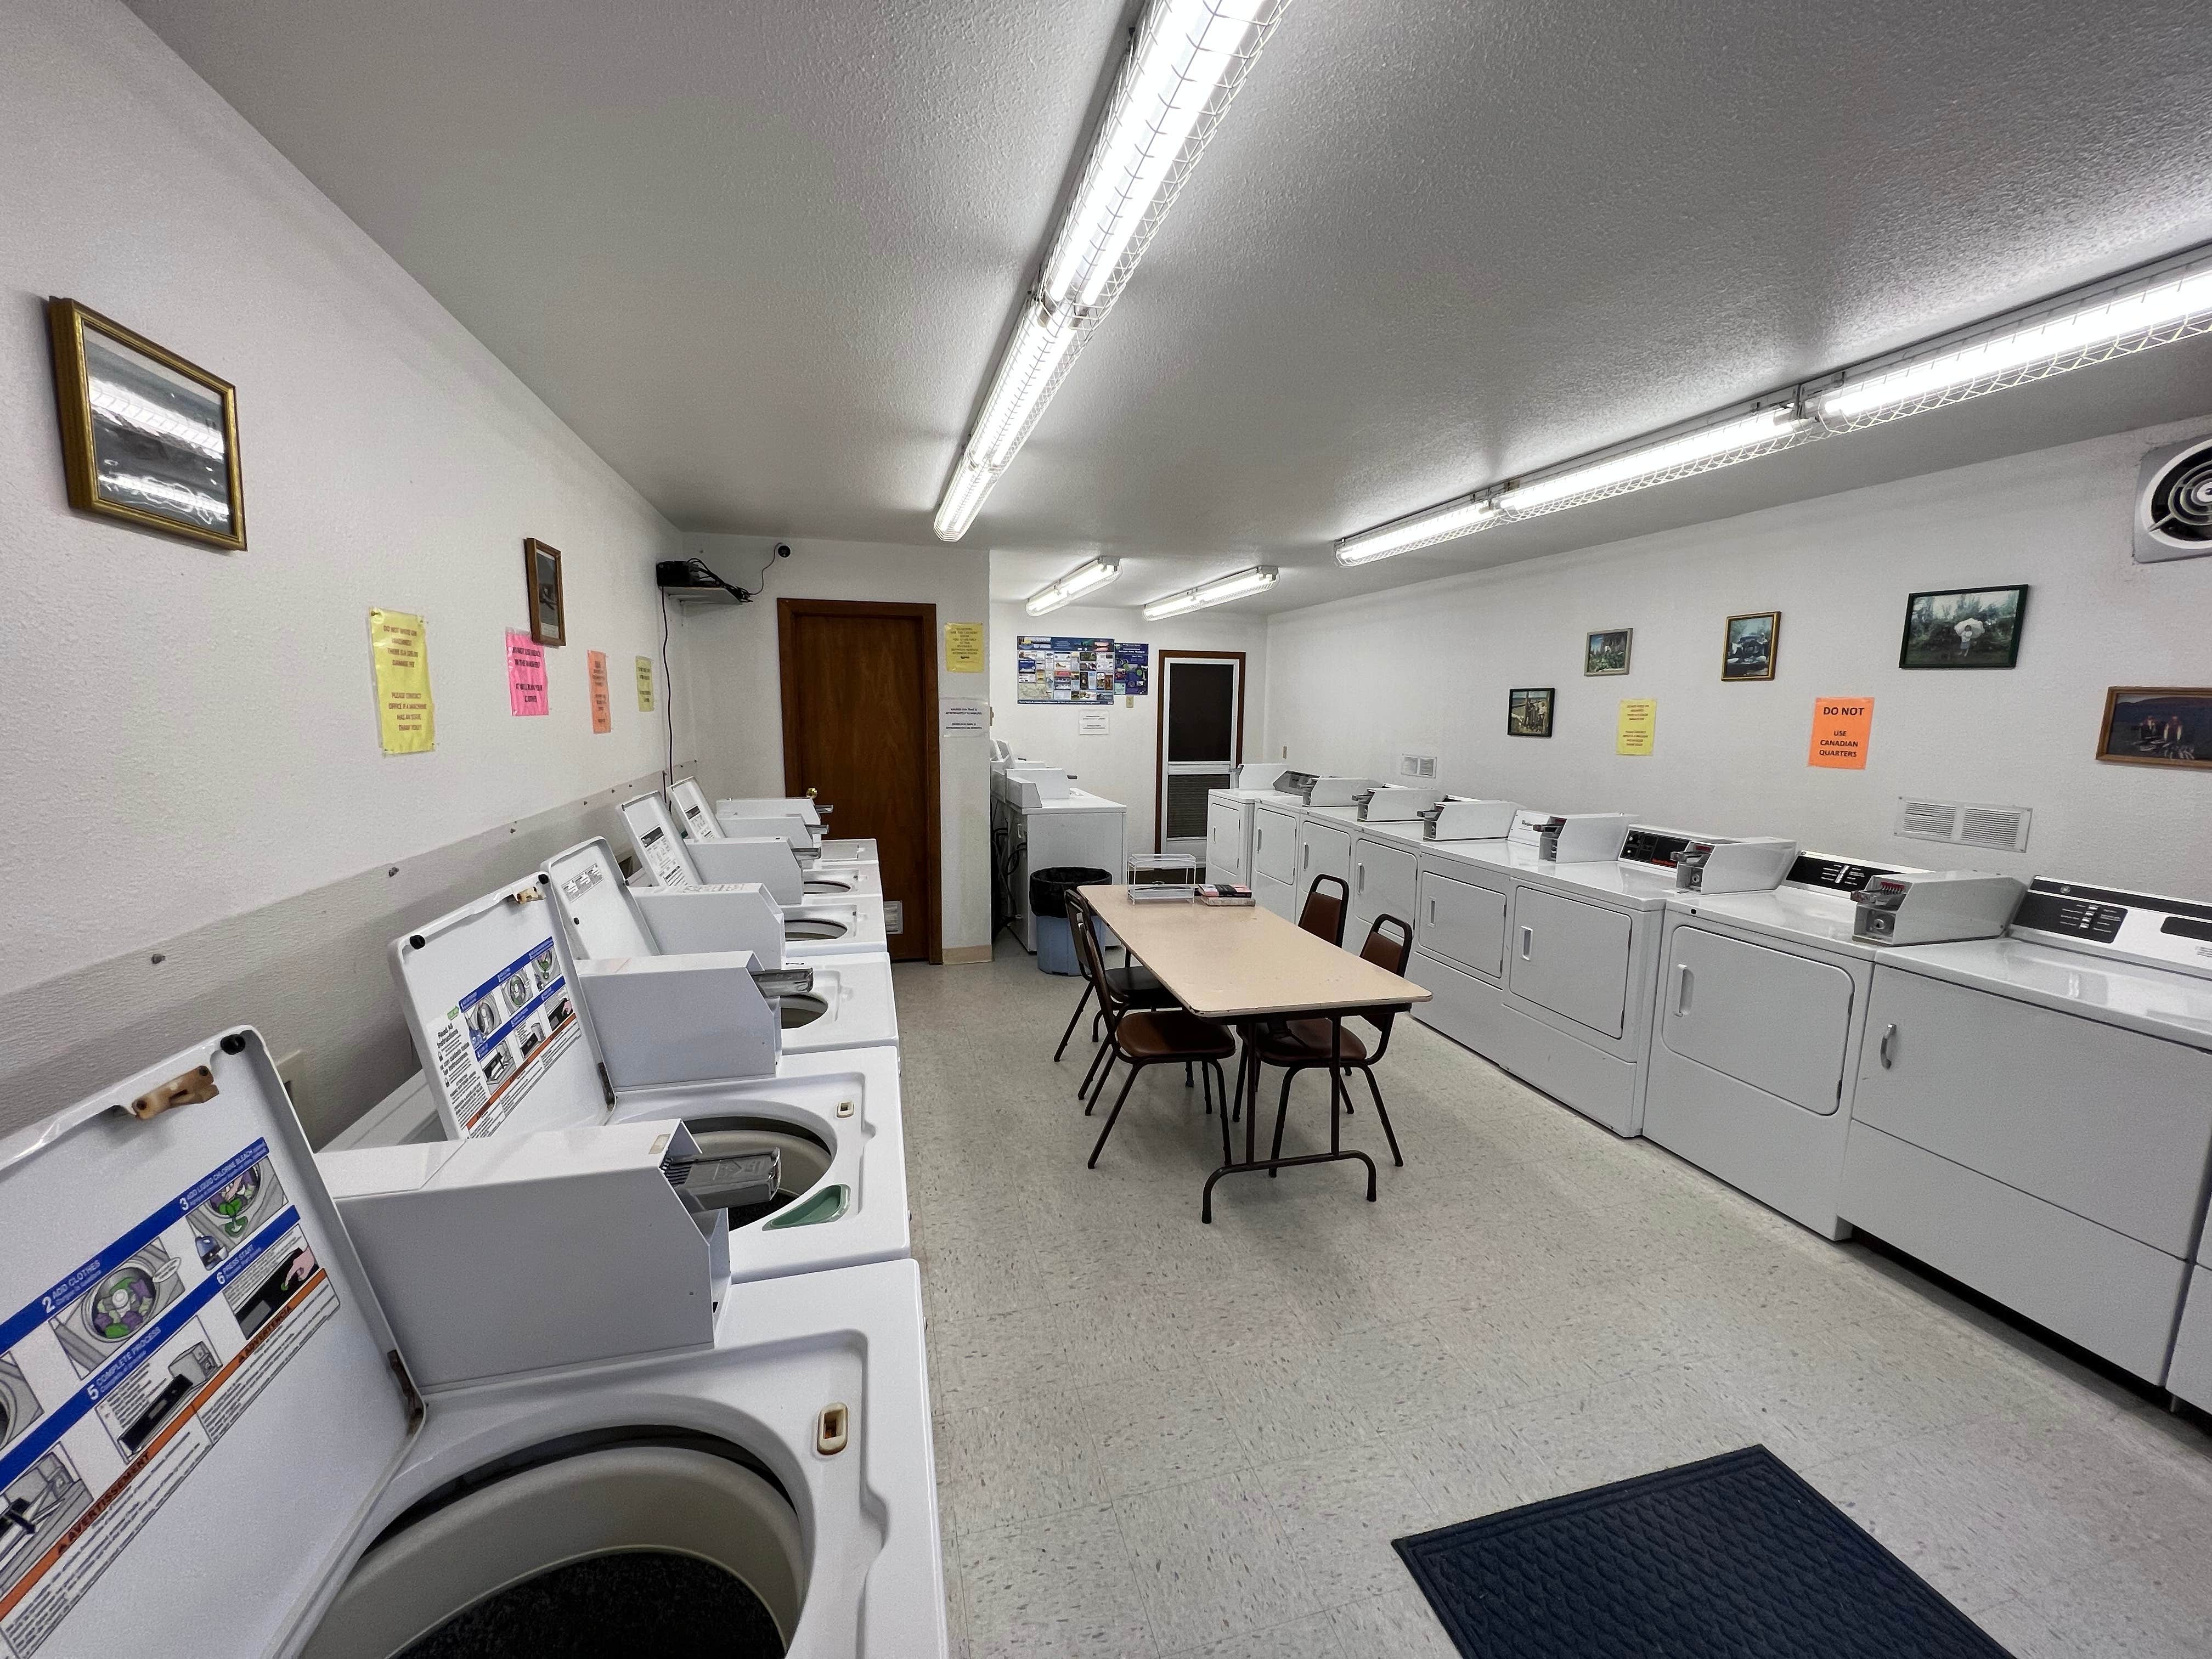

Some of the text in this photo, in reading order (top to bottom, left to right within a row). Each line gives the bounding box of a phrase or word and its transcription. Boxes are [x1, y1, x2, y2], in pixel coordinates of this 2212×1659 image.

[1842, 707, 1864, 715] NOT
[1819, 749, 1857, 758] QUARTERS
[180, 1197, 189, 1210] 3
[42, 1296, 55, 1313] 2
[52, 1284, 68, 1300] ADD
[68, 1260, 100, 1286] CLOTHES
[217, 1272, 225, 1284] 6
[223, 1257, 240, 1274] PRESS
[238, 1244, 254, 1261] START
[245, 1306, 292, 1356] ADVERTENCIA
[87, 1384, 99, 1400] 5
[96, 1351, 133, 1386] COMPLETE
[131, 1327, 161, 1355] PROCESS
[68, 1453, 149, 1541] AVERTISSEMENT
